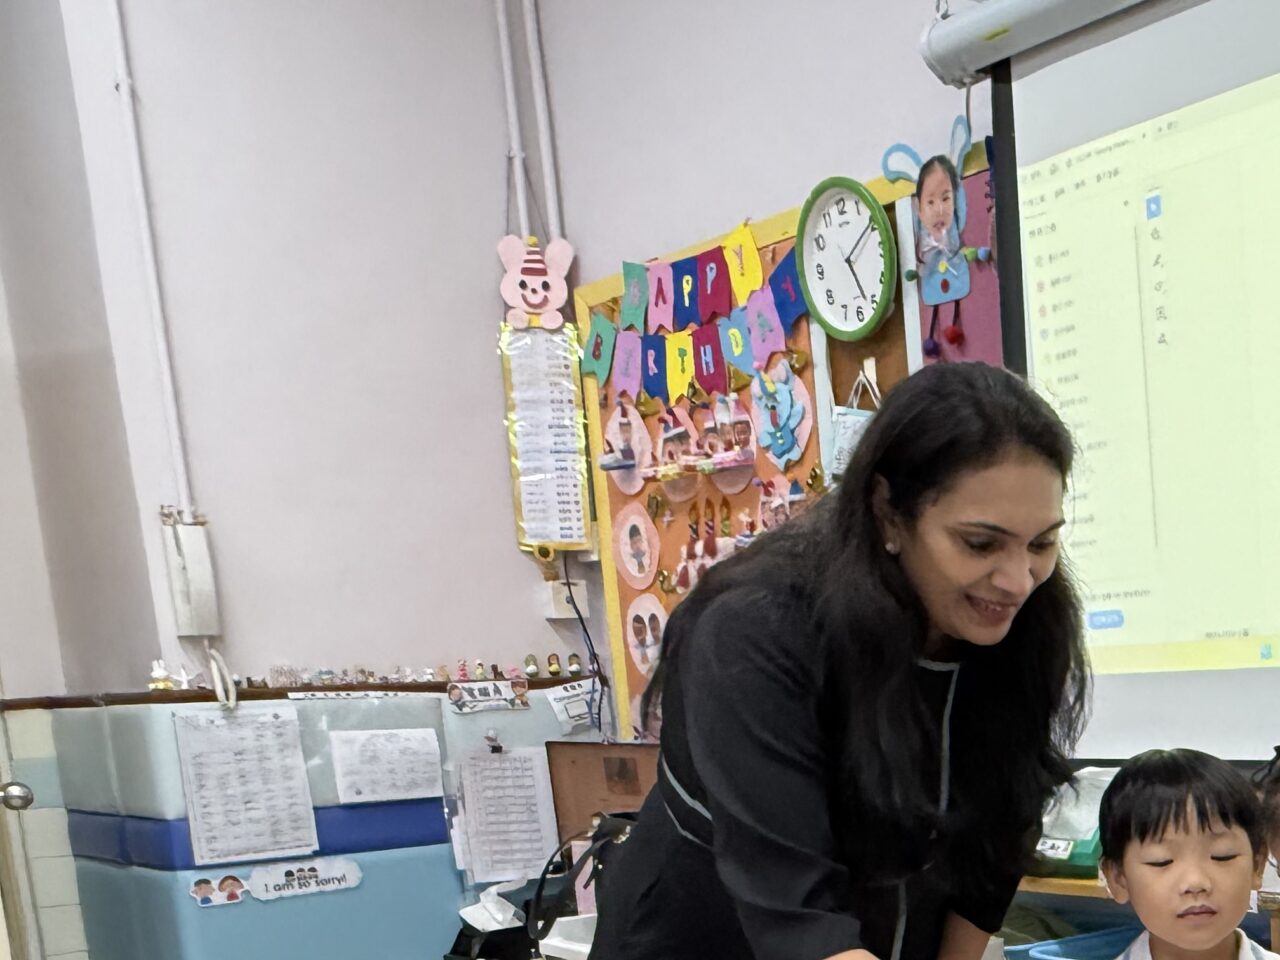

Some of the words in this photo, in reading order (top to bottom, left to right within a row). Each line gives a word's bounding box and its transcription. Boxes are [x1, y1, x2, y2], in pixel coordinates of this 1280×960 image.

[814, 234, 826, 251] 10
[274, 882, 295, 892] am
[298, 880, 311, 890] so
